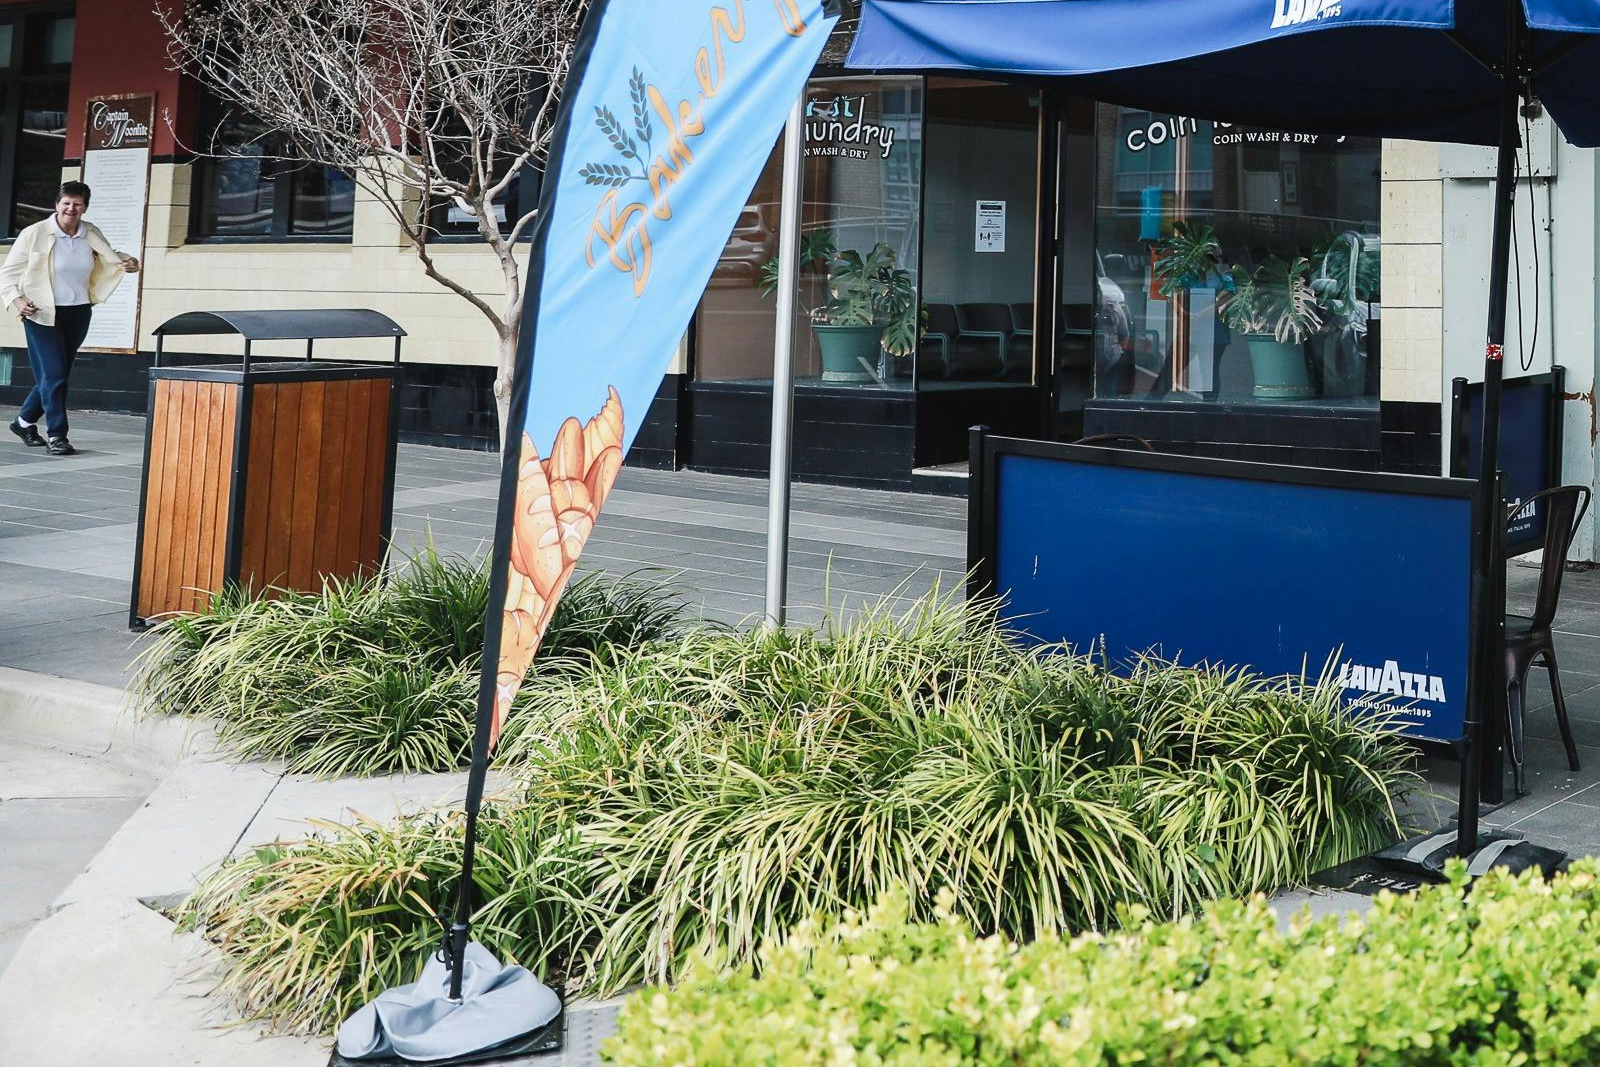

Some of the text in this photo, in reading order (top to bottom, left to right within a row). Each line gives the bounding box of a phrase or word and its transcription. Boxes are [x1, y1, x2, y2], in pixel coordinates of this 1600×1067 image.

[805, 97, 894, 158] undry
[1213, 134, 1243, 145] COIN
[1246, 132, 1280, 143] WASH
[1282, 132, 1291, 143] &
[1294, 133, 1318, 144] DRY
[813, 147, 838, 156] WASH
[841, 148, 847, 157] &
[850, 149, 868, 159] DRY
[1340, 660, 1446, 703] LAVAZZA
[1413, 707, 1432, 718] 1895
